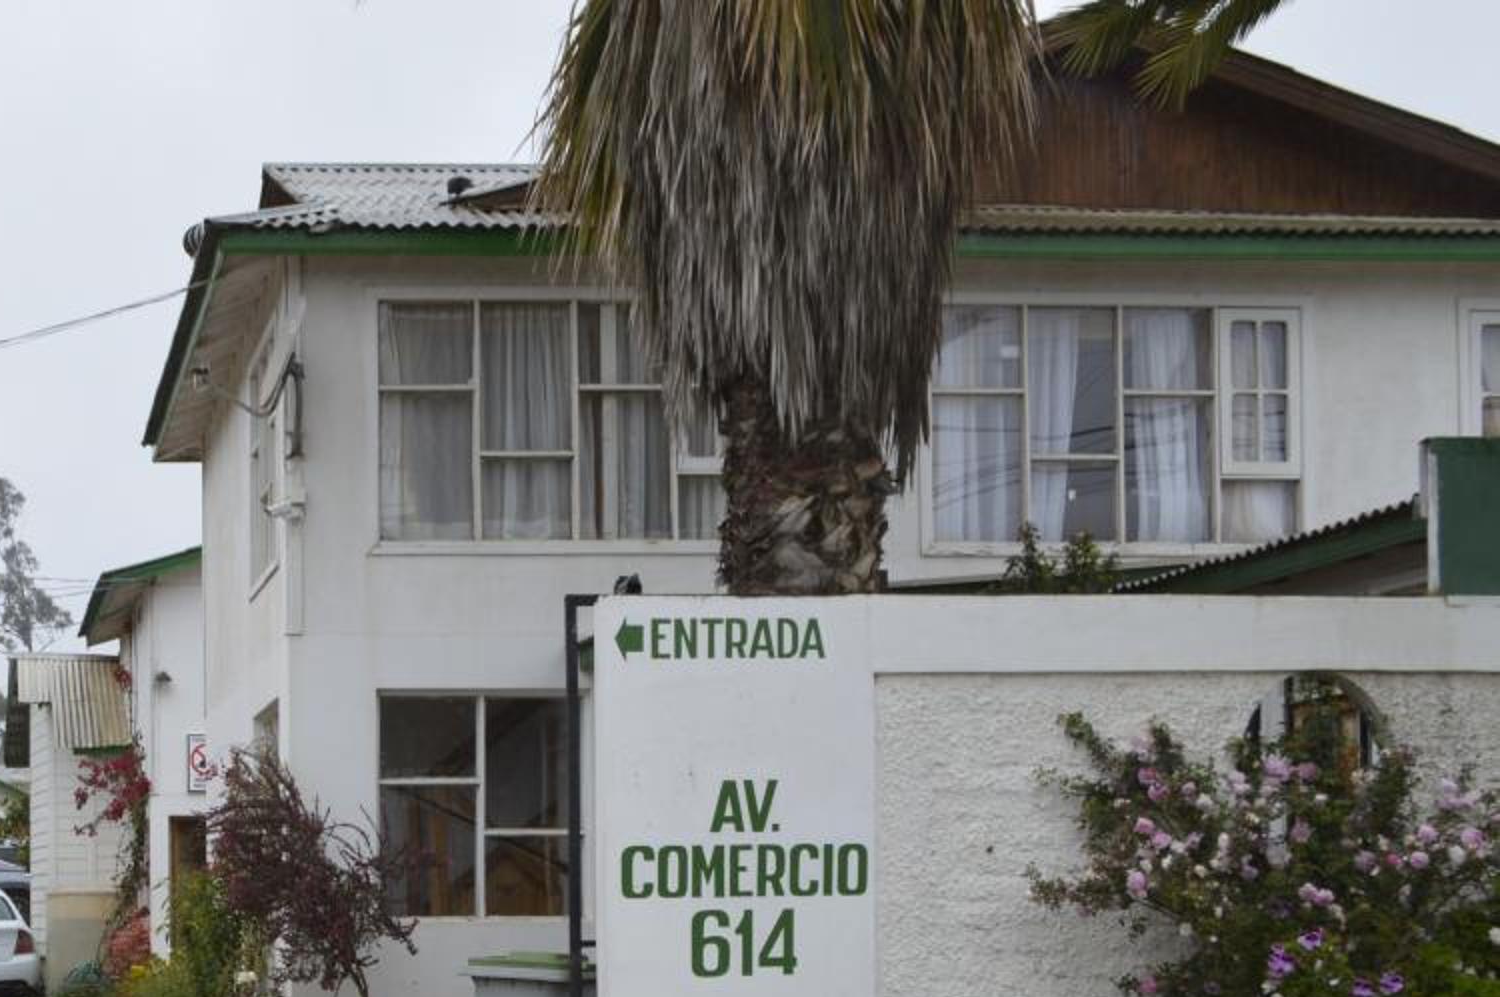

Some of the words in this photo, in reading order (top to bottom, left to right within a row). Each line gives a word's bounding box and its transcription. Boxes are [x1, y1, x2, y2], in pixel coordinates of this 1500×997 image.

[650, 618, 826, 660] ENTRADA
[710, 779, 780, 834] AV.
[620, 842, 870, 899] COMERCIO
[690, 908, 799, 978] 614
